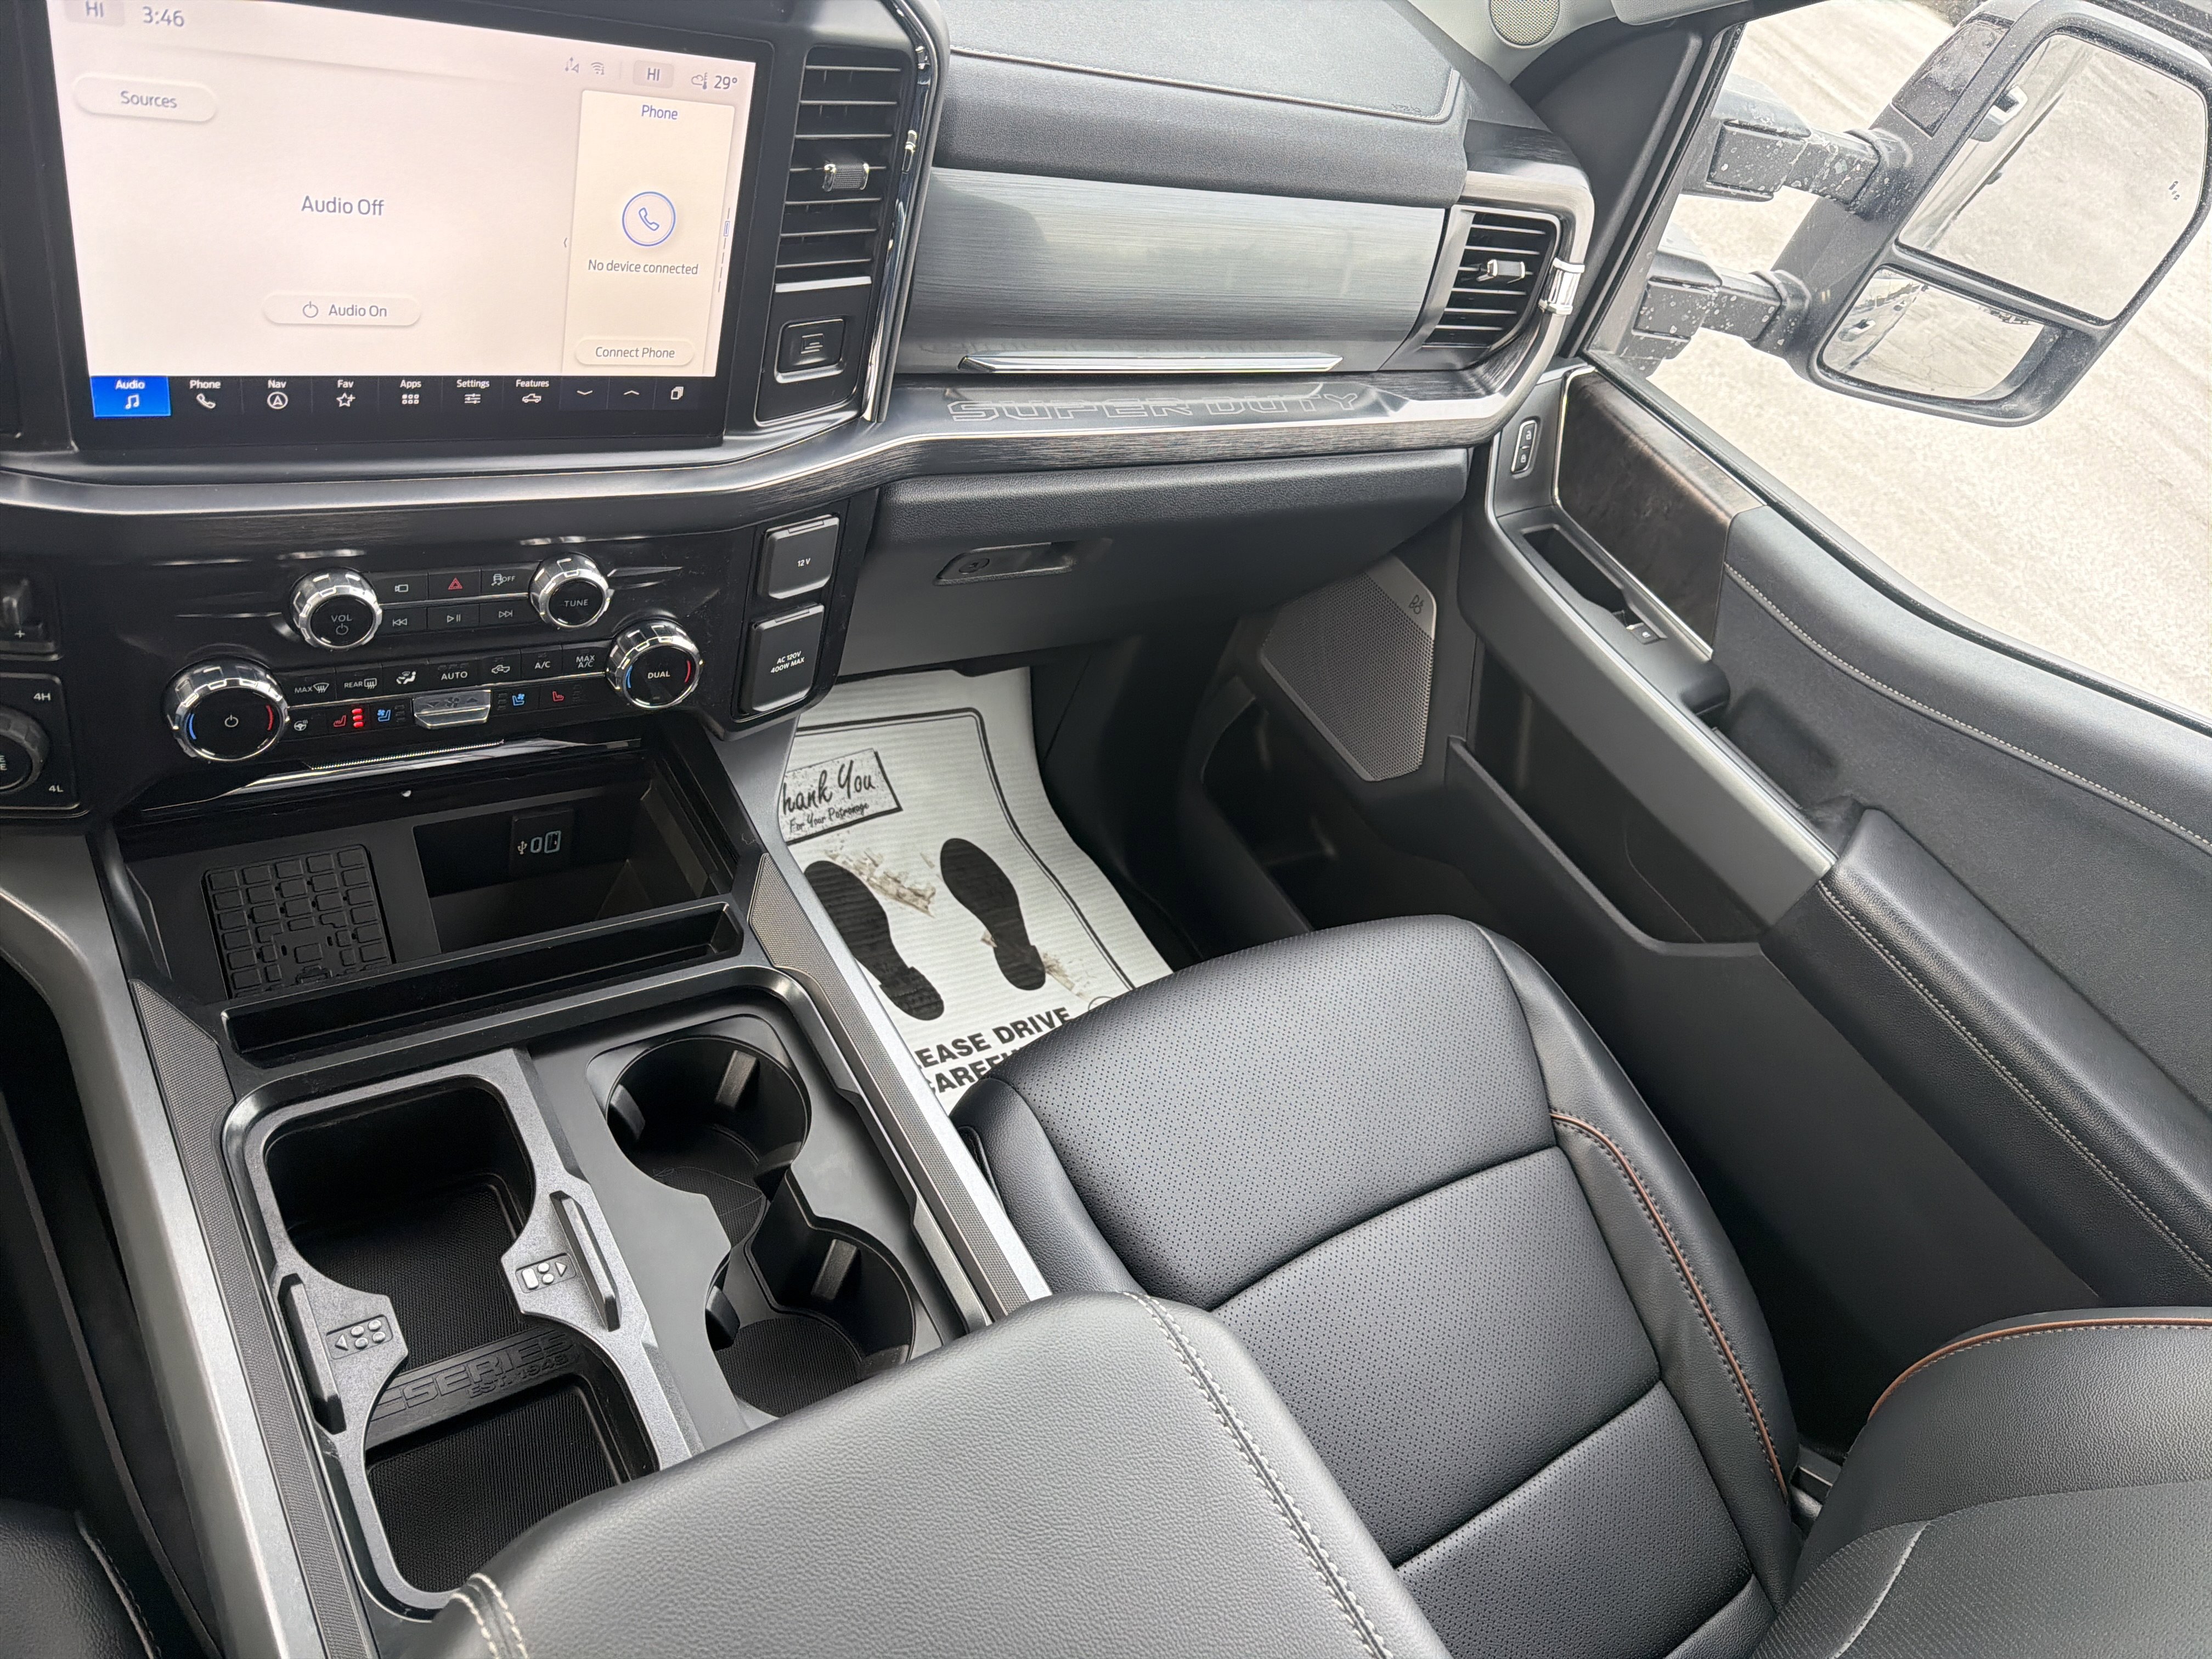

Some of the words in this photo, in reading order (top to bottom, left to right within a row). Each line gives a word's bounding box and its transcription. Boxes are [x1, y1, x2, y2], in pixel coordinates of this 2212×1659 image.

[86, 0, 104, 18] HI
[142, 5, 185, 27] 3:46
[646, 67, 661, 81] HI
[120, 90, 178, 109] Sources
[641, 104, 678, 120] Phone
[301, 195, 354, 214] Audio
[357, 198, 385, 216] Off
[588, 259, 604, 271] No
[606, 259, 641, 273] device
[643, 263, 699, 275] connected
[328, 303, 366, 317] Audio
[368, 304, 387, 317] On
[595, 346, 639, 358] Connect
[641, 347, 675, 358] Phone
[115, 380, 145, 390] Audio
[189, 380, 221, 390] Phone
[268, 380, 287, 389] Nav
[337, 379, 354, 388] Fav
[399, 379, 422, 390] Apps
[456, 379, 490, 390] Settings
[516, 379, 550, 388] Features
[947, 398, 1193, 422] SUPER
[1202, 393, 1358, 415] DUTY
[797, 560, 805, 568] 12
[331, 614, 353, 623] VOL
[786, 651, 802, 661] 120V
[534, 661, 551, 669] A/C
[770, 662, 789, 673] 400W
[791, 657, 805, 667] MAX
[441, 670, 468, 680] AUTO
[647, 670, 670, 679] DUAL
[294, 685, 313, 693] MAX
[33, 692, 51, 701] 4H
[782, 770, 833, 815] hank
[838, 759, 876, 799] You
[790, 817, 804, 832] For
[992, 1007, 1071, 1044] DRIVE
